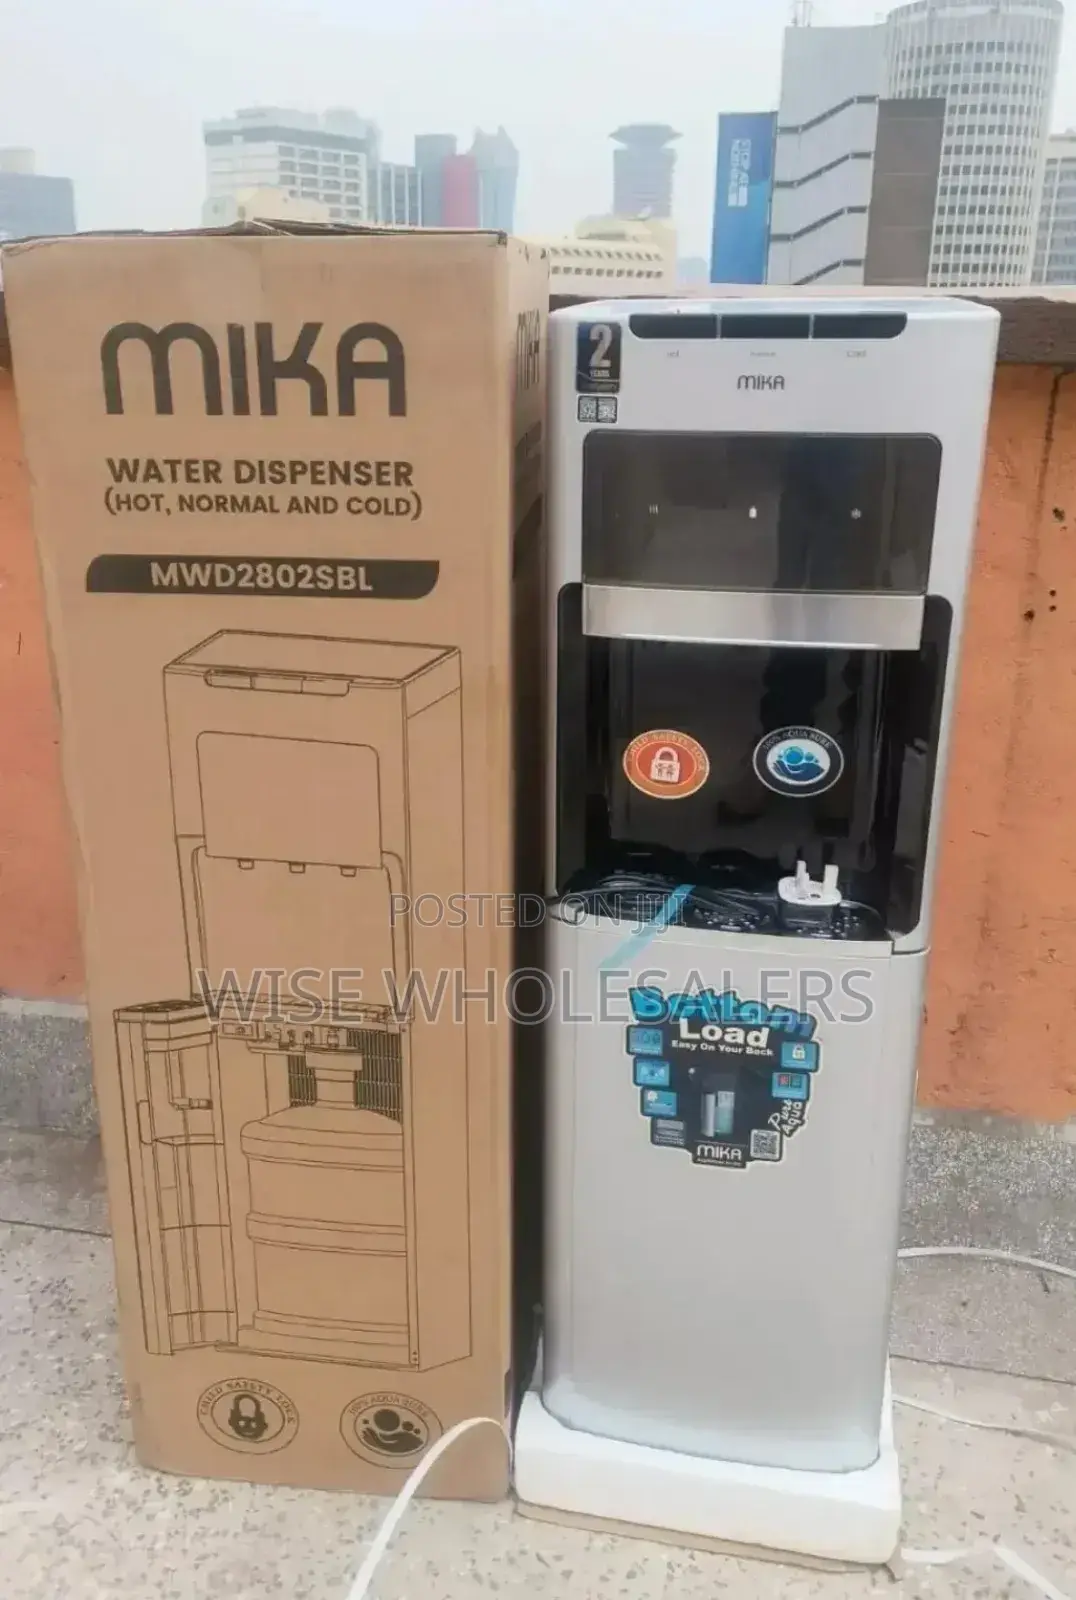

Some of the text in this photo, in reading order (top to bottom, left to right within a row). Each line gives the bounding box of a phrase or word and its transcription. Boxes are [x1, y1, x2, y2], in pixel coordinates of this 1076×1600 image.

[589, 323, 612, 368] 2
[100, 322, 407, 417] MIKA
[736, 374, 785, 391] MIKA
[106, 458, 414, 487] WATER DISPENSER
[104, 491, 423, 520] (HOT, NORMAL AND COLD)
[149, 562, 374, 592] MWD2802SBL
[679, 1017, 770, 1048] Load
[671, 1040, 698, 1052] Easy
[700, 1042, 716, 1052] On
[719, 1044, 743, 1054] Your
[745, 1047, 774, 1057] Back
[768, 1099, 792, 1132] Pure
[782, 1101, 803, 1134] Aqua
[697, 1144, 742, 1161] MIKA
